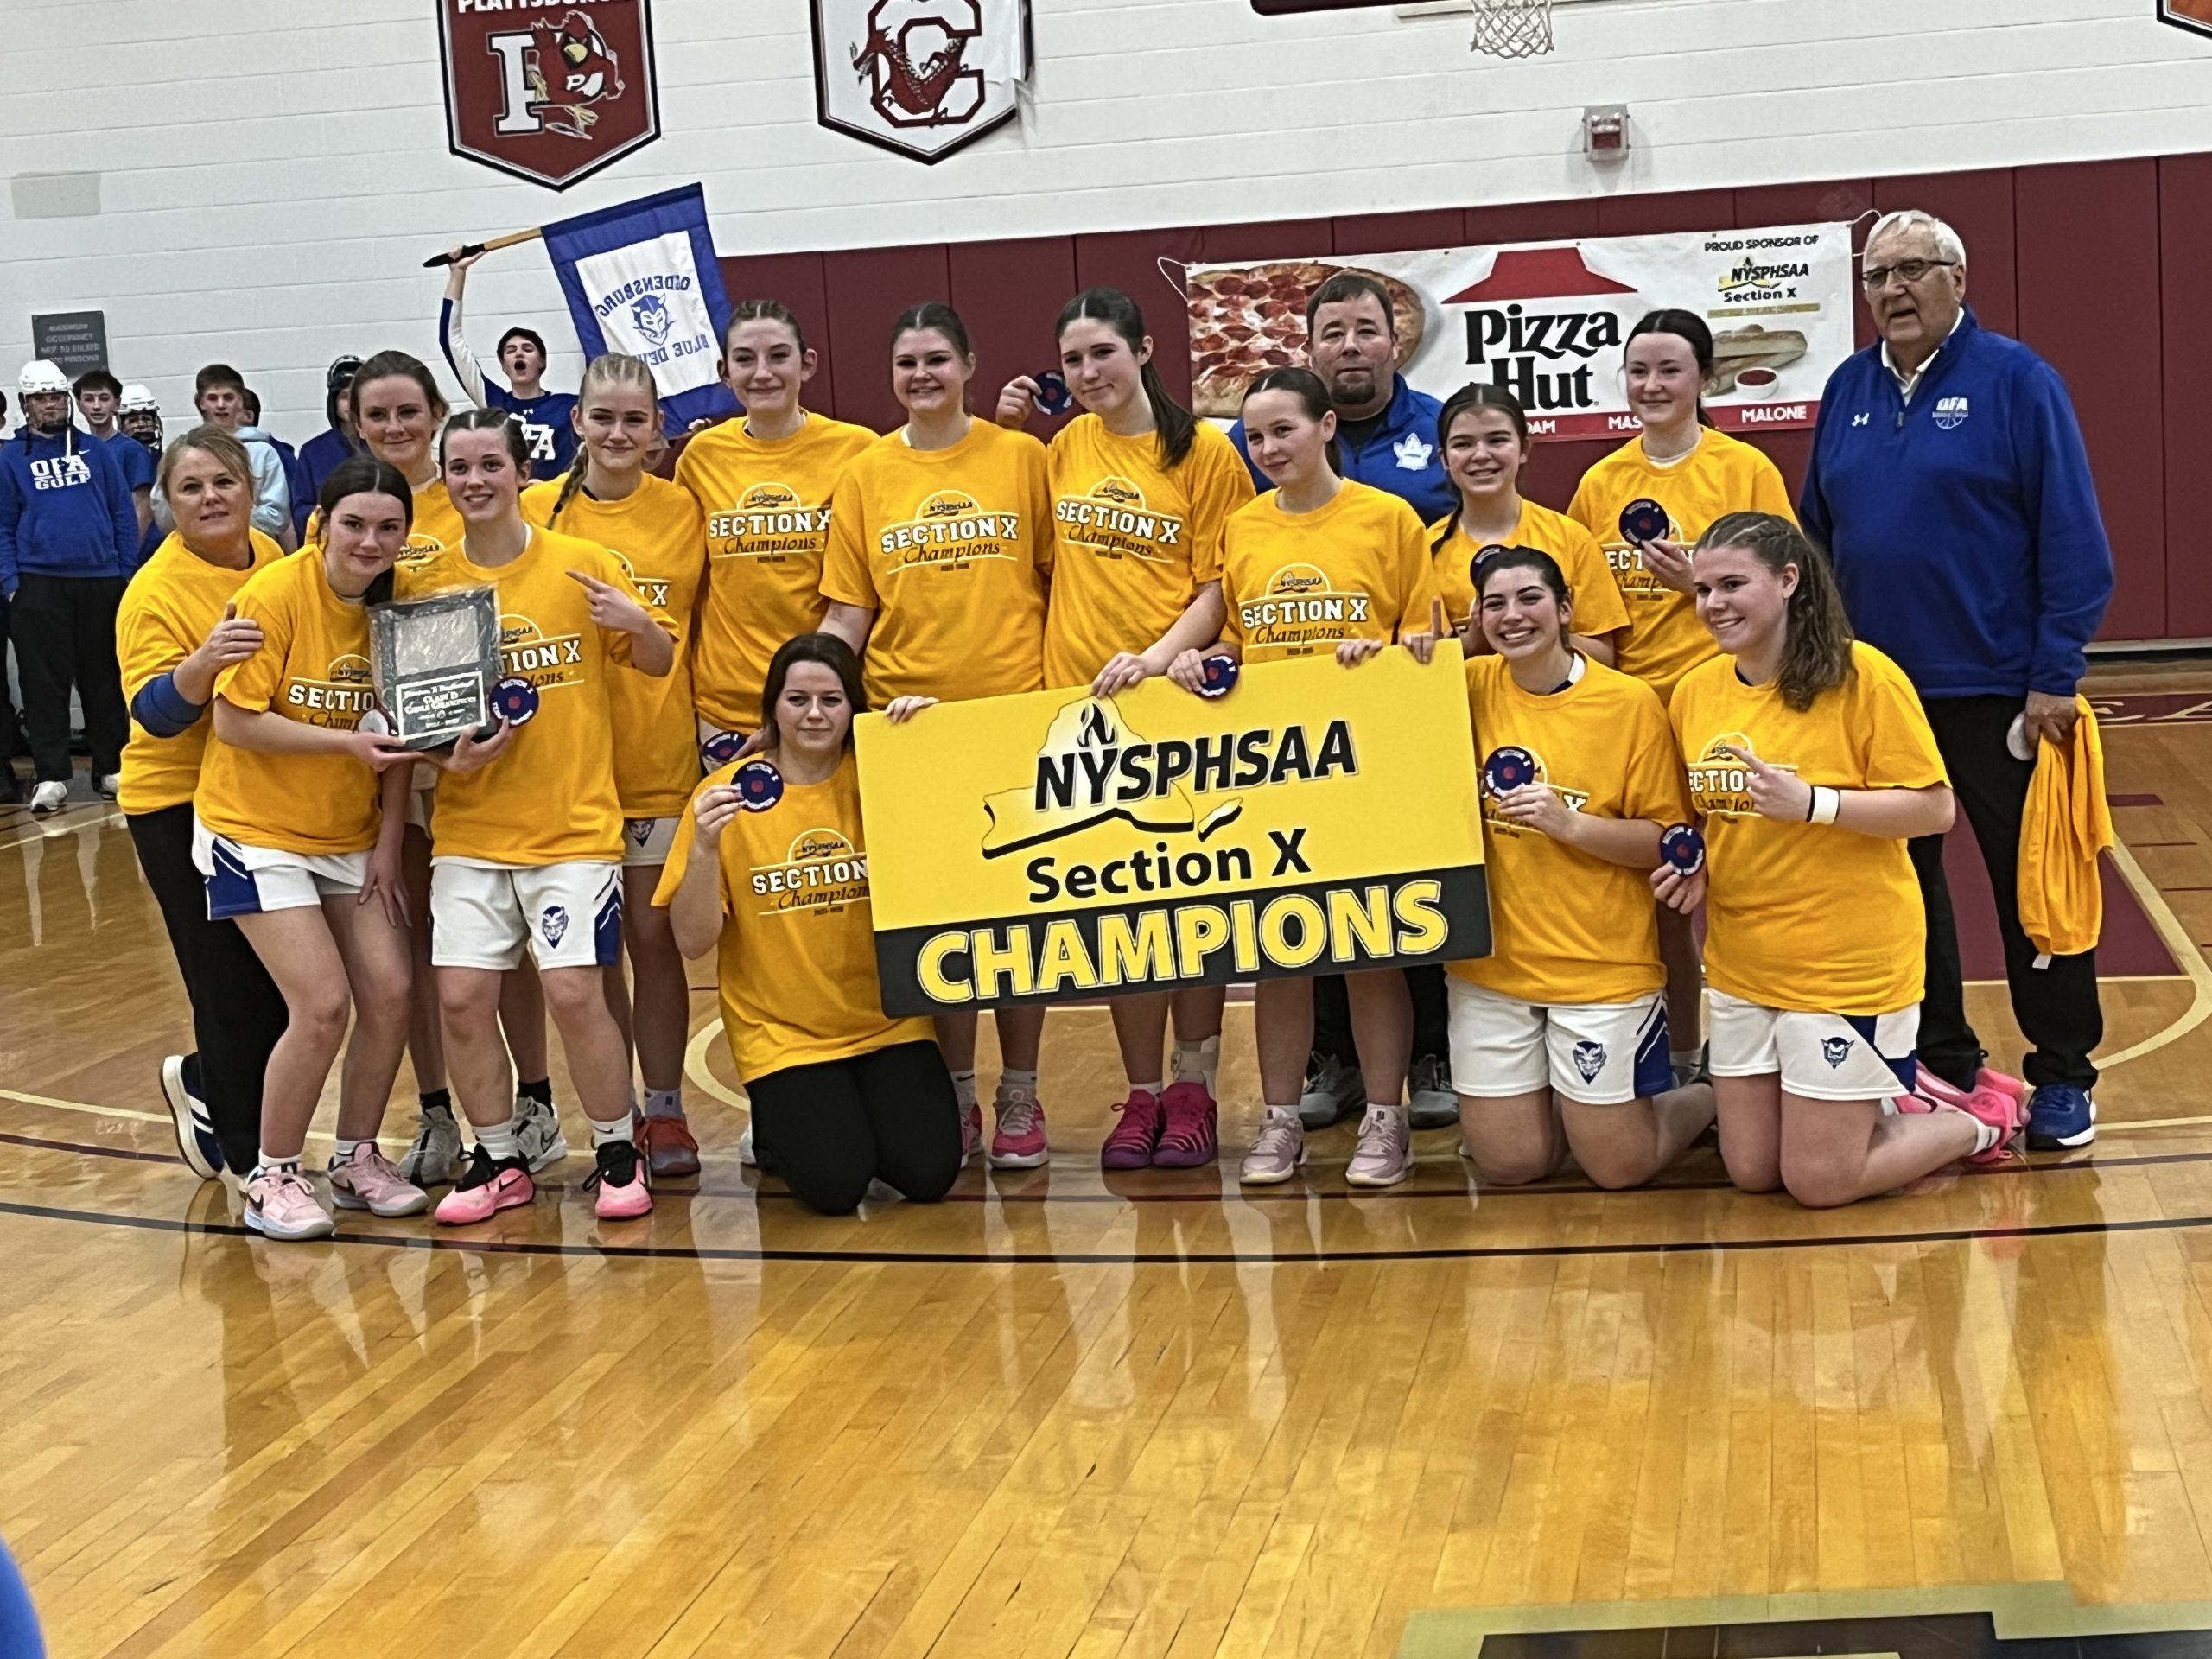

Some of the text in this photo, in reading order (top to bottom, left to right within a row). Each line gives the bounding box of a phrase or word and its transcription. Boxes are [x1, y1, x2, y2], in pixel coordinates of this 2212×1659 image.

[1704, 235, 1819, 252] PROUD SPONSOR OF
[1731, 263, 1809, 283] NYSPHSAA
[1723, 287, 1796, 302] Section X
[1464, 304, 1622, 365] Pizza
[1491, 357, 1595, 410] Hut
[1526, 405, 1807, 435] DAM MAS MALONE
[709, 512, 814, 539] SECTION
[880, 516, 1019, 555] SECTION X
[1055, 499, 1182, 544] SECTION X
[723, 536, 817, 555] Champions
[904, 541, 1001, 565] Champions
[1068, 524, 1154, 557] Champions
[1240, 598, 1369, 629] SECTION X
[1255, 624, 1345, 646] Champions
[563, 639, 582, 664] X
[288, 683, 376, 712] SECTIO
[1034, 720, 1359, 811] NYSPHSAA
[752, 858, 869, 896] SECTION
[1027, 827, 1312, 903] Section X
[778, 884, 872, 909] Champion
[917, 880, 1451, 1004] CHAMPIONS
